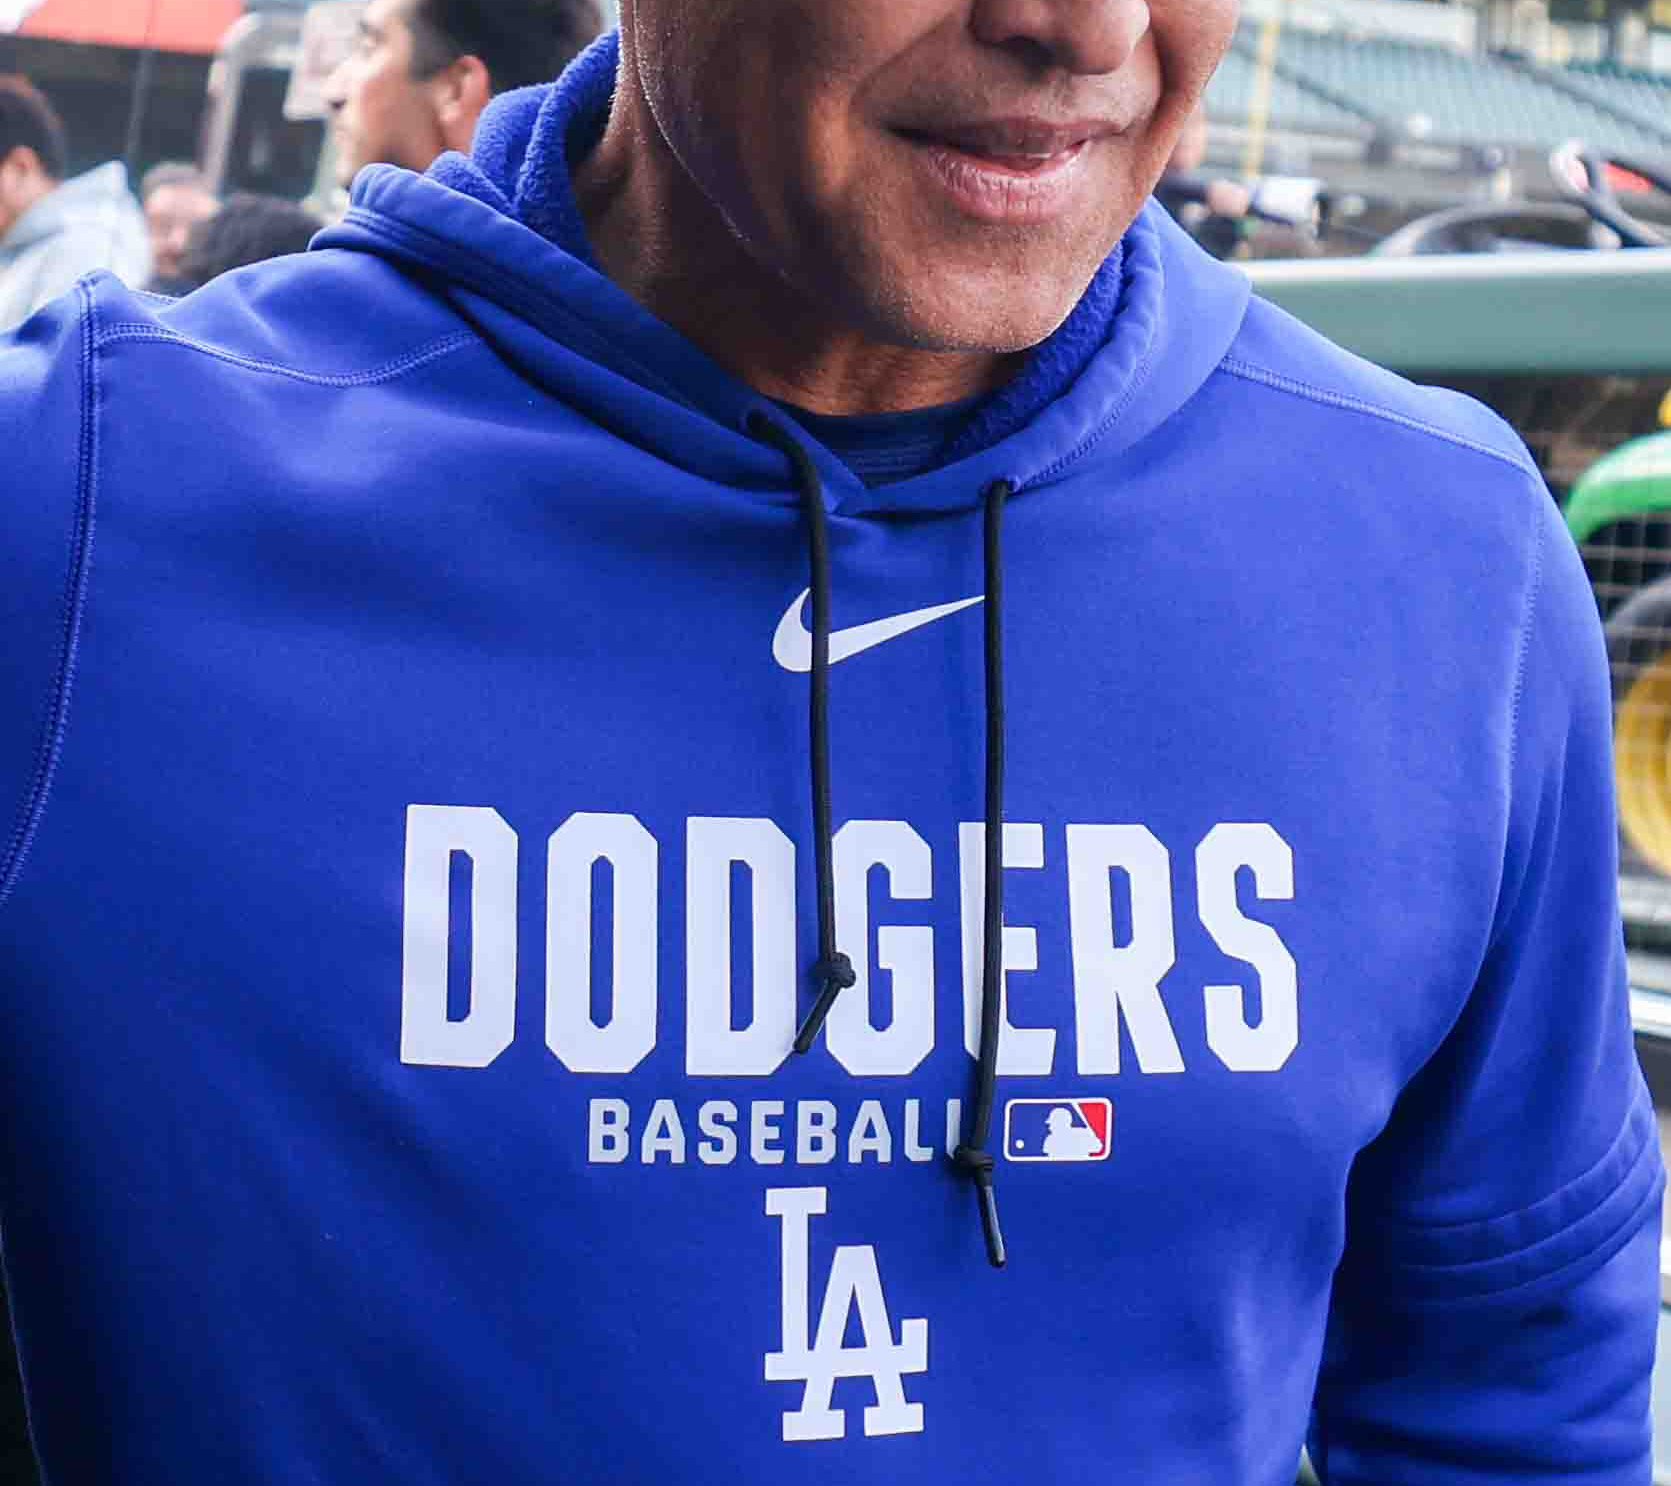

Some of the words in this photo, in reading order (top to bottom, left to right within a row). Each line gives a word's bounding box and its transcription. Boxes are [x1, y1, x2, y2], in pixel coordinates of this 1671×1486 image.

[399, 803, 1299, 1076] DODGERS
[588, 1098, 962, 1165] BASEBALL
[764, 1186, 928, 1442] LA
